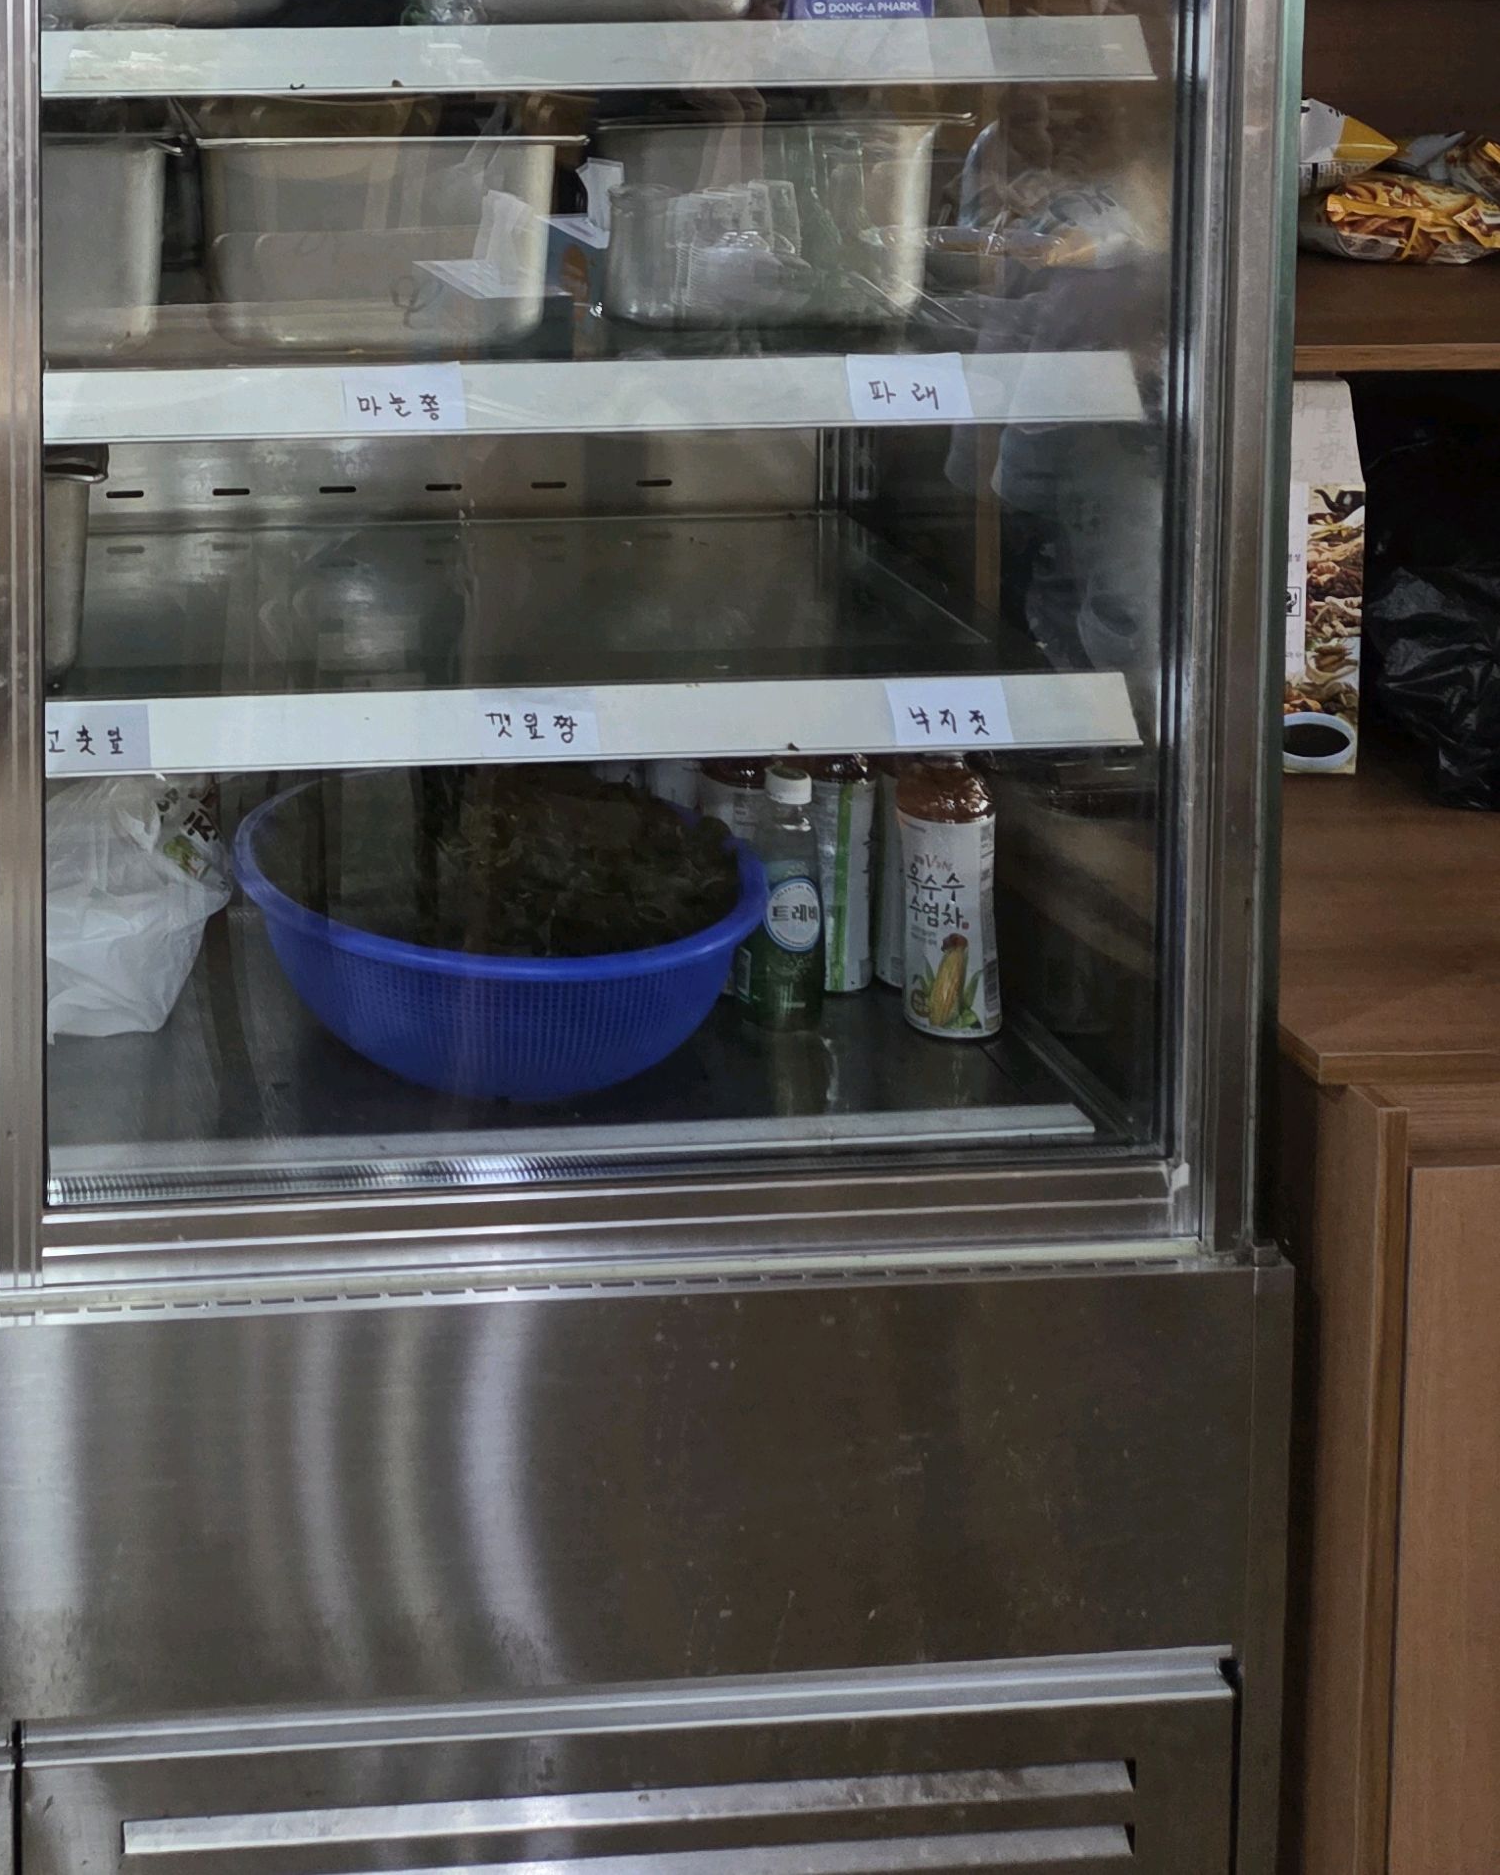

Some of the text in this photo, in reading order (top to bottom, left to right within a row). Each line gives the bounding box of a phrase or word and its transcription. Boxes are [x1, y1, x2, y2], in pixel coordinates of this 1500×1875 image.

[828, 2, 877, 14] DONG-A
[867, 380, 940, 410] 파래
[907, 706, 991, 736] 낙지젓
[906, 863, 965, 903] 옥수수
[909, 894, 964, 929] 수염차
